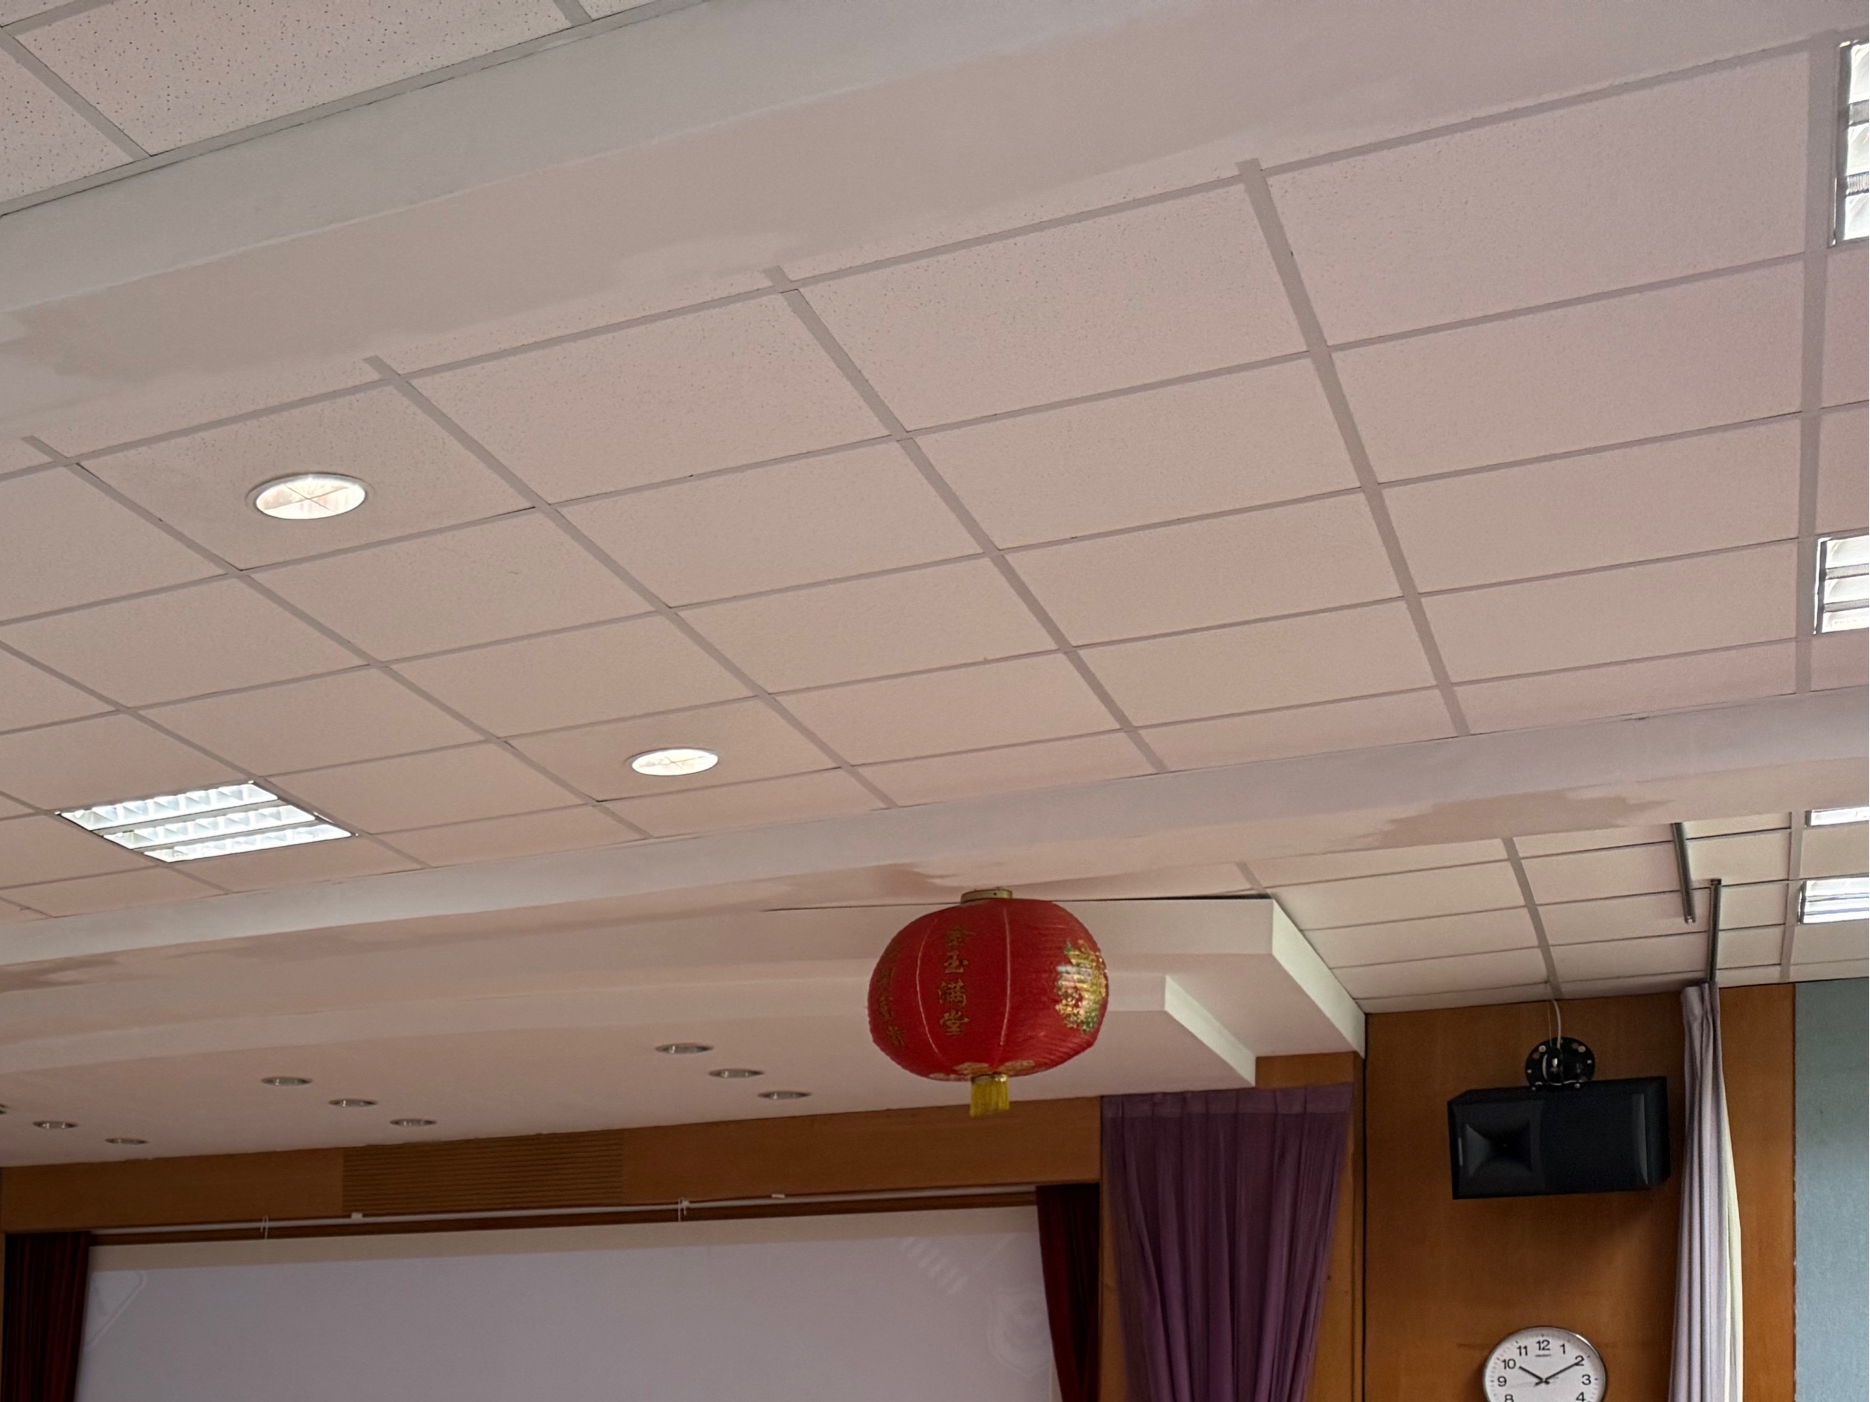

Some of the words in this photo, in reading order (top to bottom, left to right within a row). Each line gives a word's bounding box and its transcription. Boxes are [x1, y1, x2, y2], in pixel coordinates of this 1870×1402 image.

[1517, 1345, 1528, 1356] 11
[1535, 1339, 1551, 1351] 12
[1560, 1343, 1566, 1355] 1
[1502, 1358, 1516, 1369] 10
[1574, 1355, 1585, 1366] 2
[1497, 1376, 1507, 1387] 9
[1581, 1374, 1591, 1385] 3
[1575, 1391, 1586, 1402] 4
